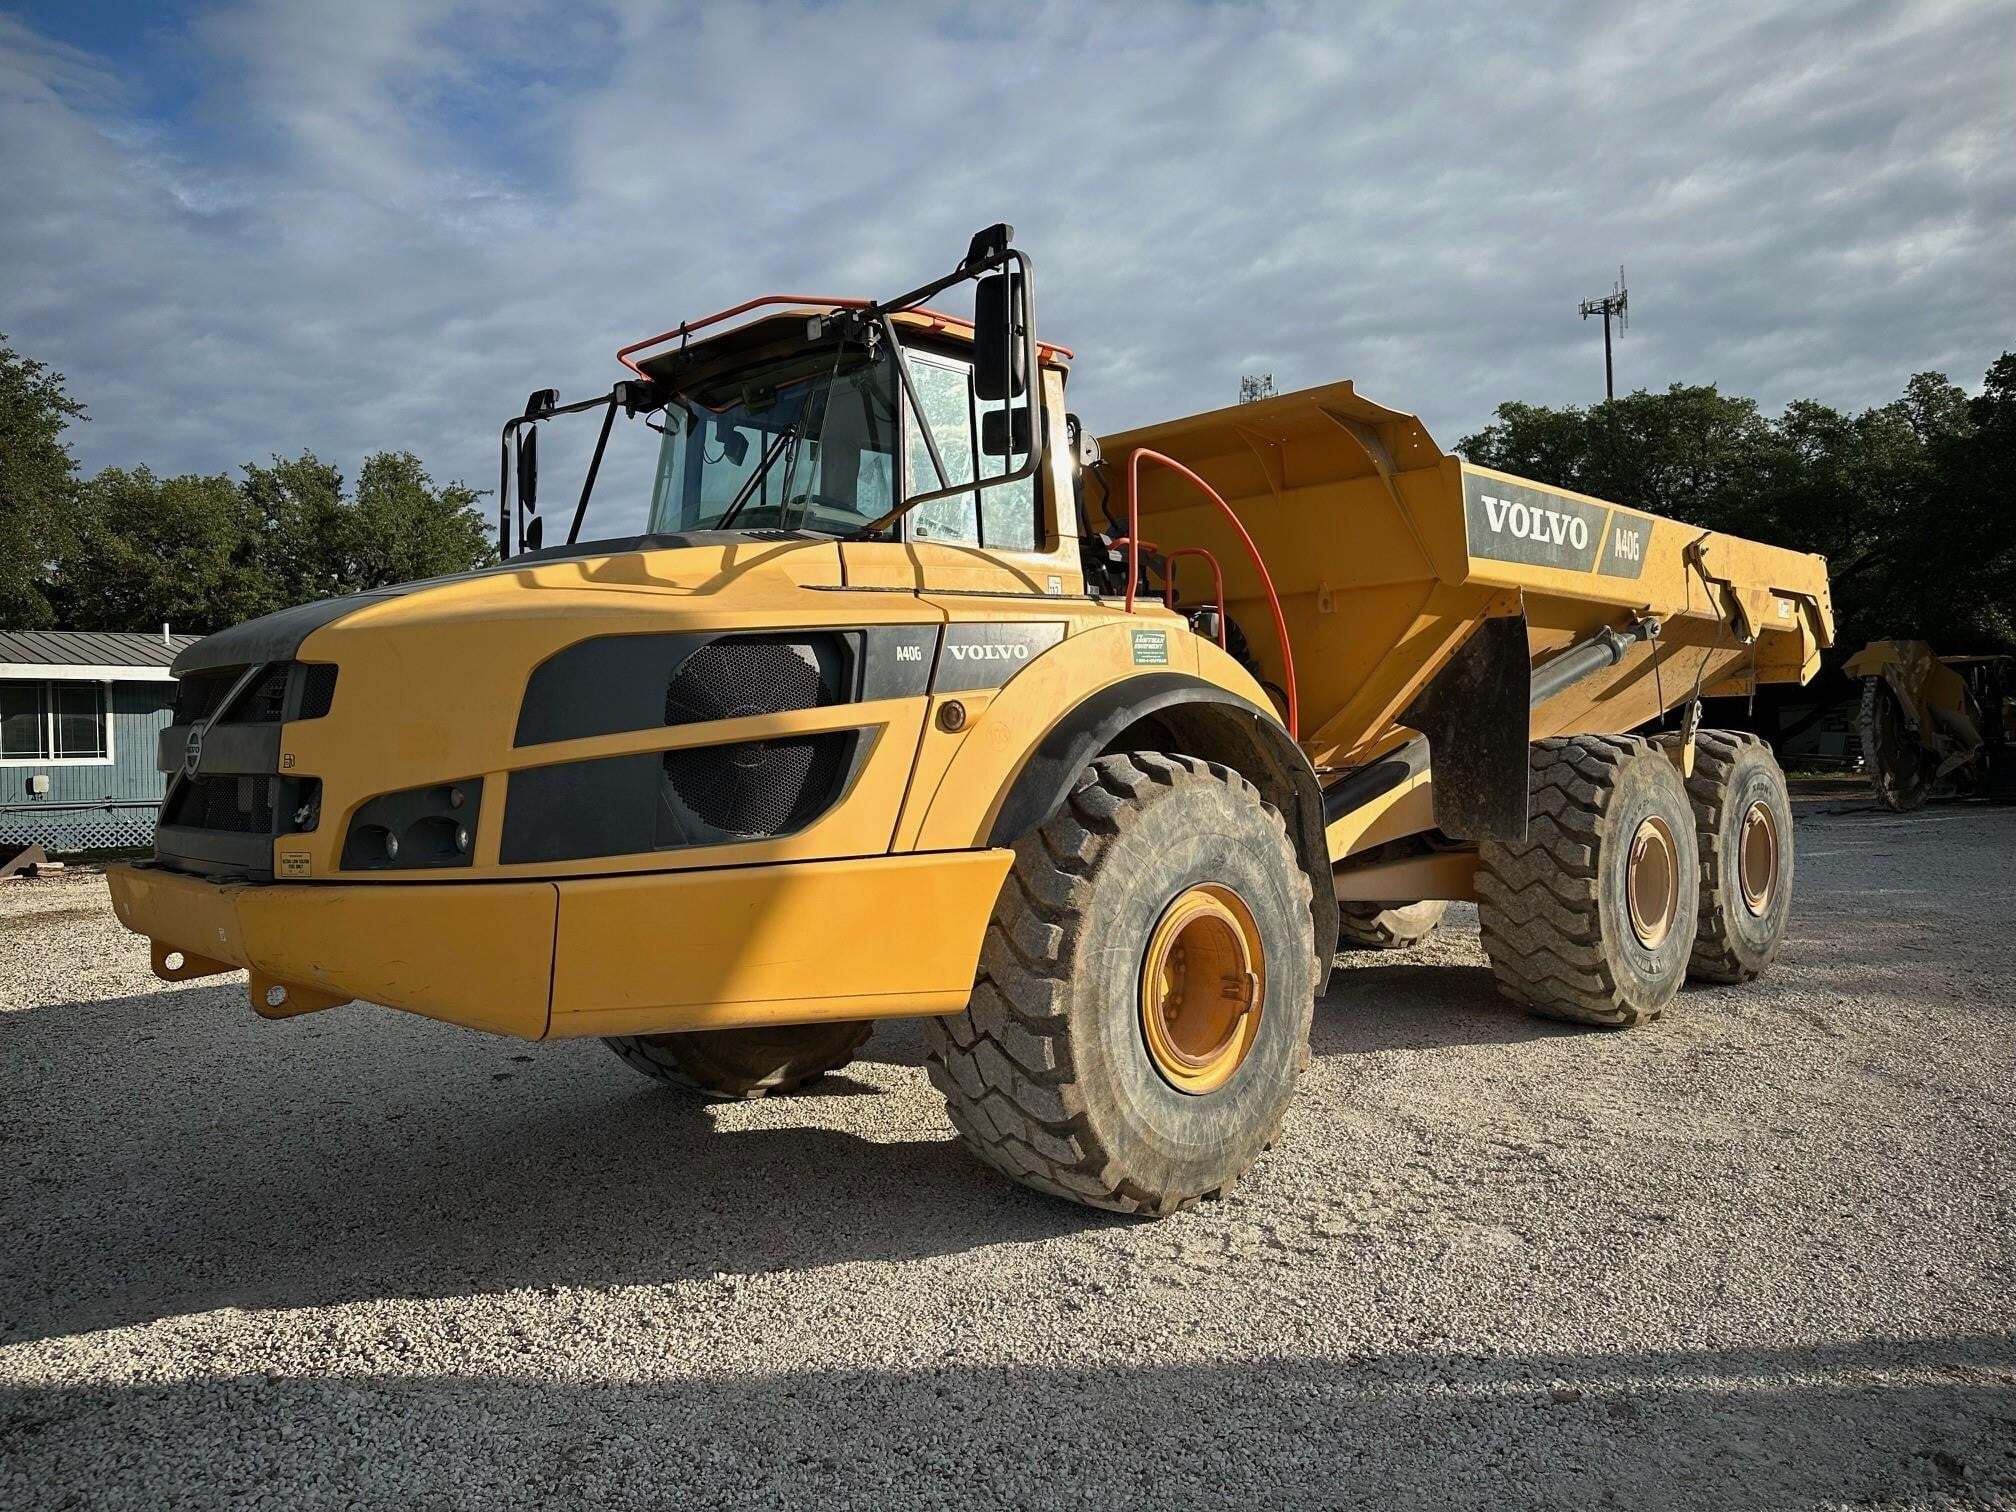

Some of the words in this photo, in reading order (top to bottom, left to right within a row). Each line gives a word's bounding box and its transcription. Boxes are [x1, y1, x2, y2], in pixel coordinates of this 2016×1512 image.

[1480, 494, 1588, 550] VOLVO
[1614, 527, 1640, 562] A40G
[896, 646, 922, 661] A40G
[947, 644, 1029, 660] VOLVO
